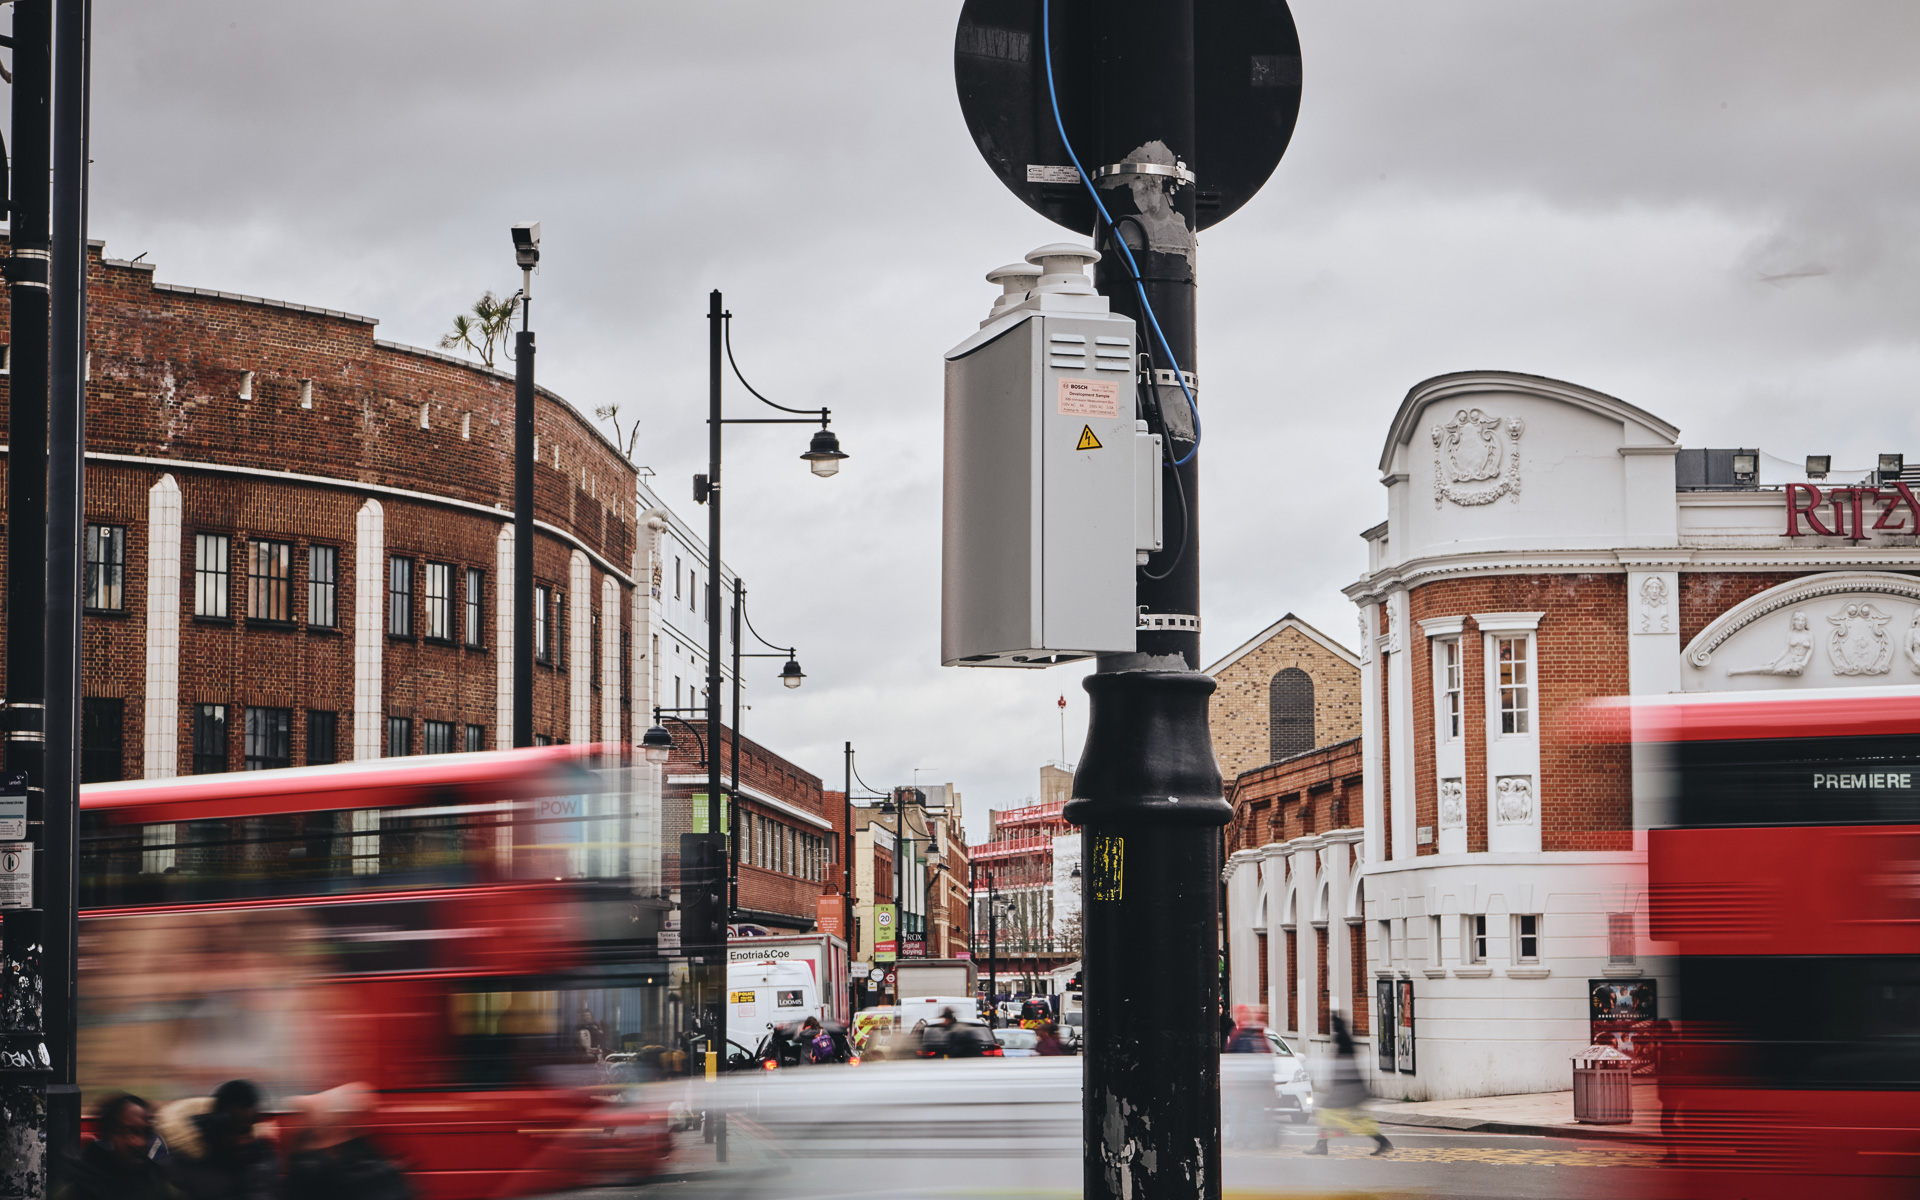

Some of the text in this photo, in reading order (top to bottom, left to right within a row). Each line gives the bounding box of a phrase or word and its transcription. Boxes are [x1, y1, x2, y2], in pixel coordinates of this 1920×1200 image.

[1813, 773, 1912, 789] PREMIERE
[540, 800, 577, 815] POW
[730, 950, 790, 960] Enotria&Coe
[779, 998, 803, 1006] LOOMIS
